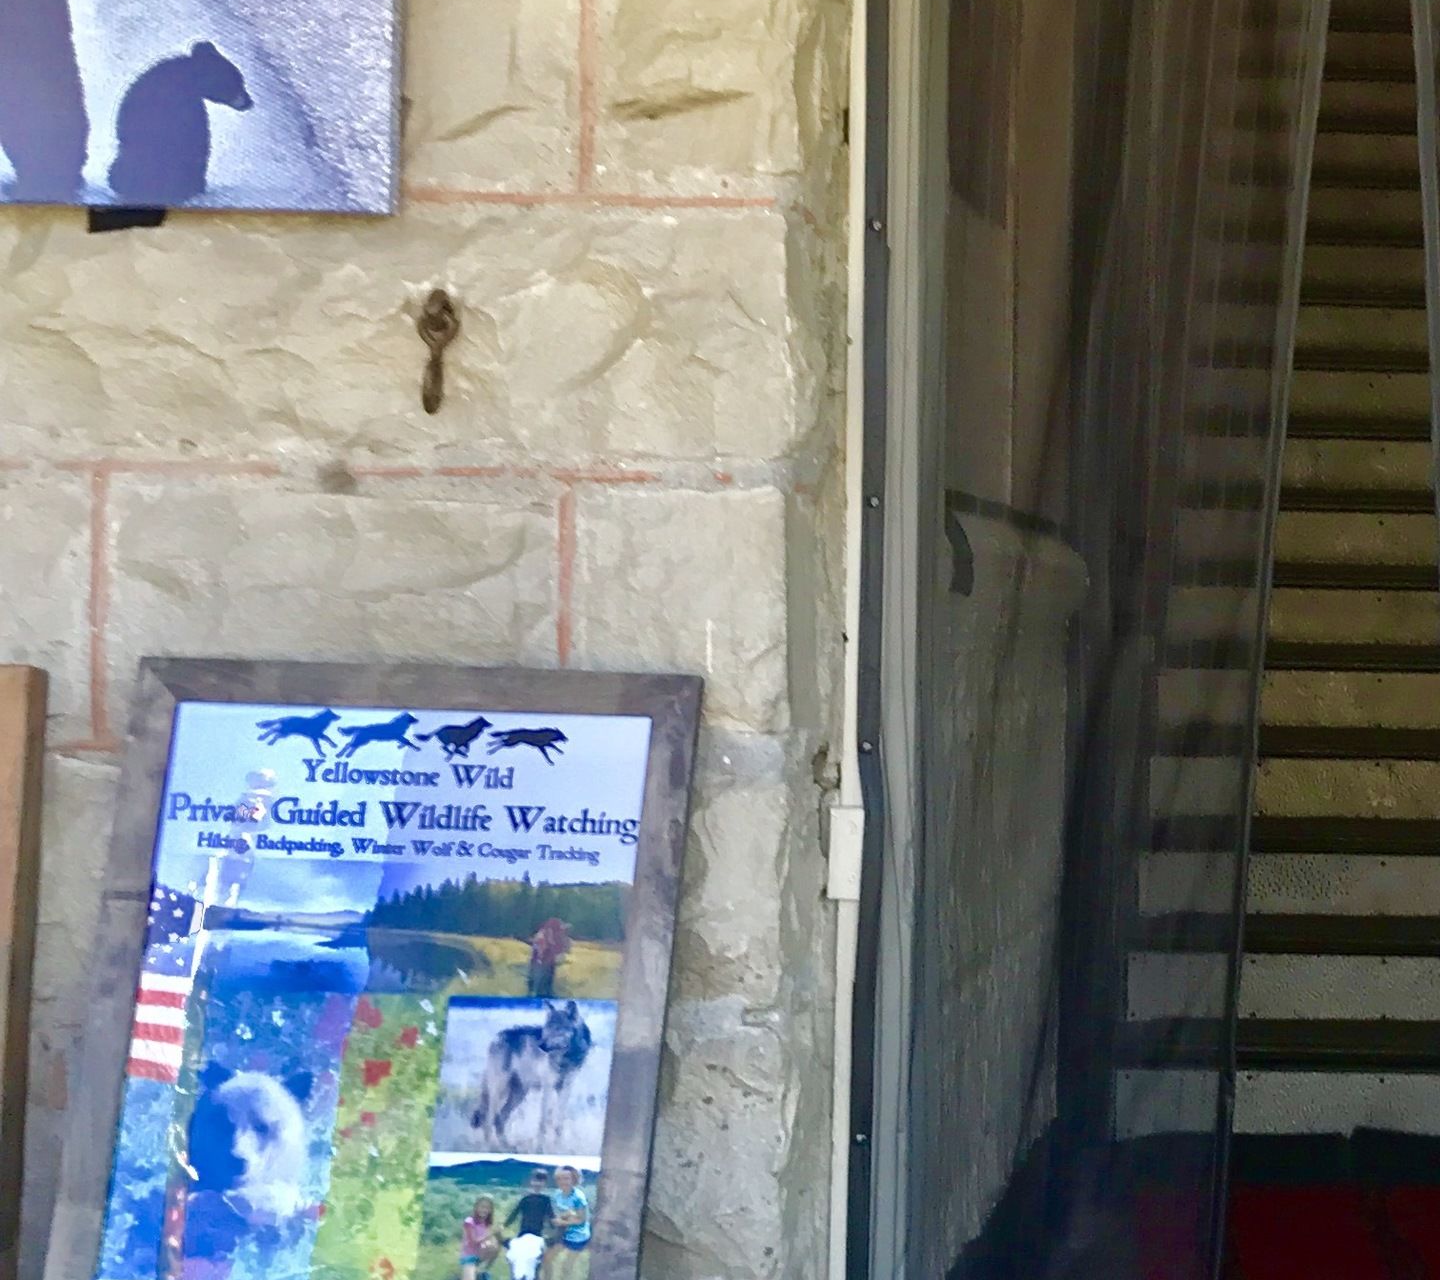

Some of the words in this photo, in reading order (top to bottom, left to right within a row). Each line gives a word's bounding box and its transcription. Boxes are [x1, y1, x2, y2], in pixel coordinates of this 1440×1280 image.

[303, 759, 440, 787] Yellowstone
[450, 764, 514, 790] Wild
[271, 797, 367, 827] Guided
[379, 801, 493, 832] Wildlife
[503, 806, 640, 844] Watching
[351, 837, 405, 856] Winter
[411, 840, 455, 857] Wolf
[456, 841, 473, 857] &
[477, 842, 531, 864] Cougar
[536, 844, 600, 866] Tracking
